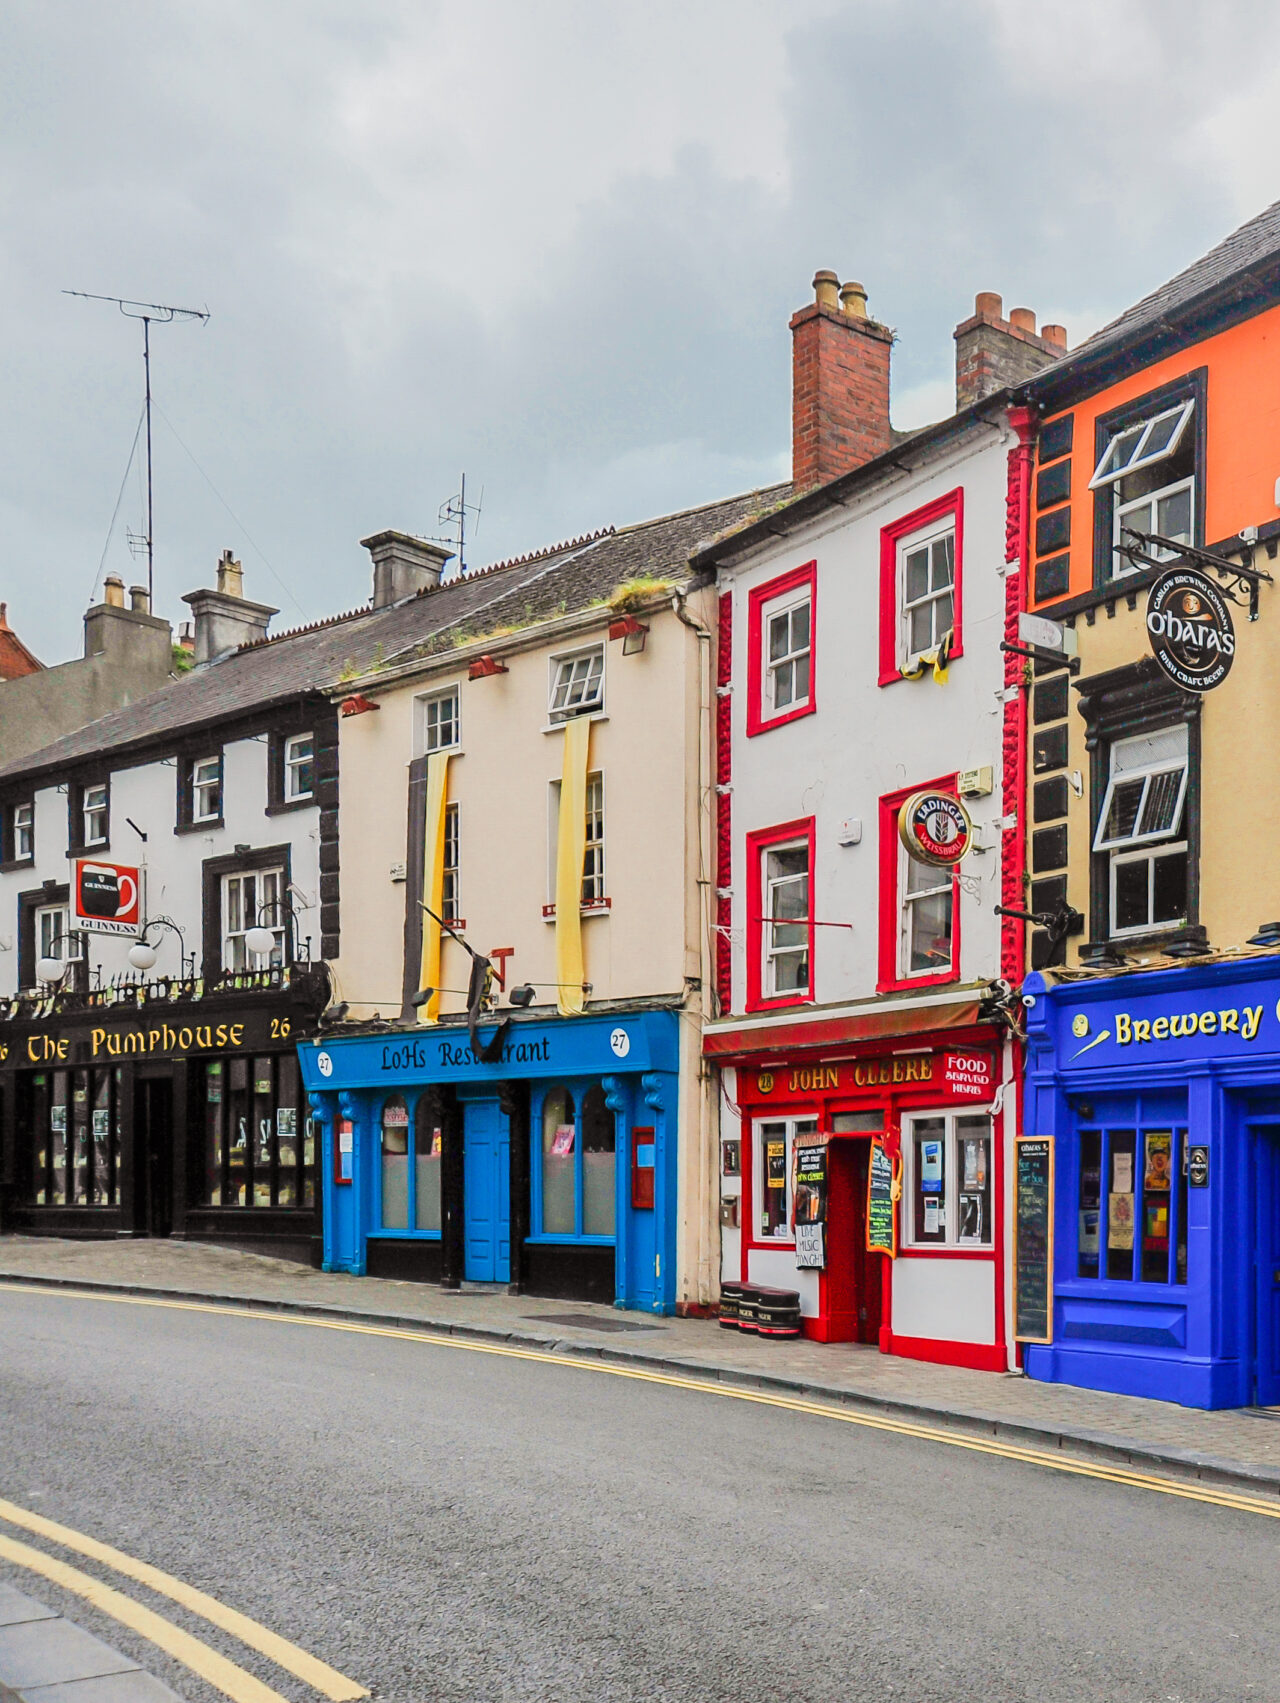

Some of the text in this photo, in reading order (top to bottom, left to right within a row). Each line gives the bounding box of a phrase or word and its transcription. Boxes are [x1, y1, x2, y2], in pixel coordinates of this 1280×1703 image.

[1154, 575, 1229, 631] CARLOW BREWING COMPANY
[1159, 650, 1225, 686] IRISH CRAFT BEERS
[917, 800, 965, 830] ERDINGER
[81, 919, 137, 934] GUINNESS
[270, 1017, 291, 1039] 26
[612, 1034, 626, 1049] 27
[380, 1041, 426, 1070] LoHs
[319, 1057, 330, 1071] 27
[948, 1056, 987, 1073] FOOD
[761, 1075, 772, 1088] 28
[789, 1058, 933, 1092] JOHN CLEERE
[945, 1071, 990, 1085] SERVED
[952, 1083, 981, 1095] HERE
[801, 1225, 814, 1237] LIVE
